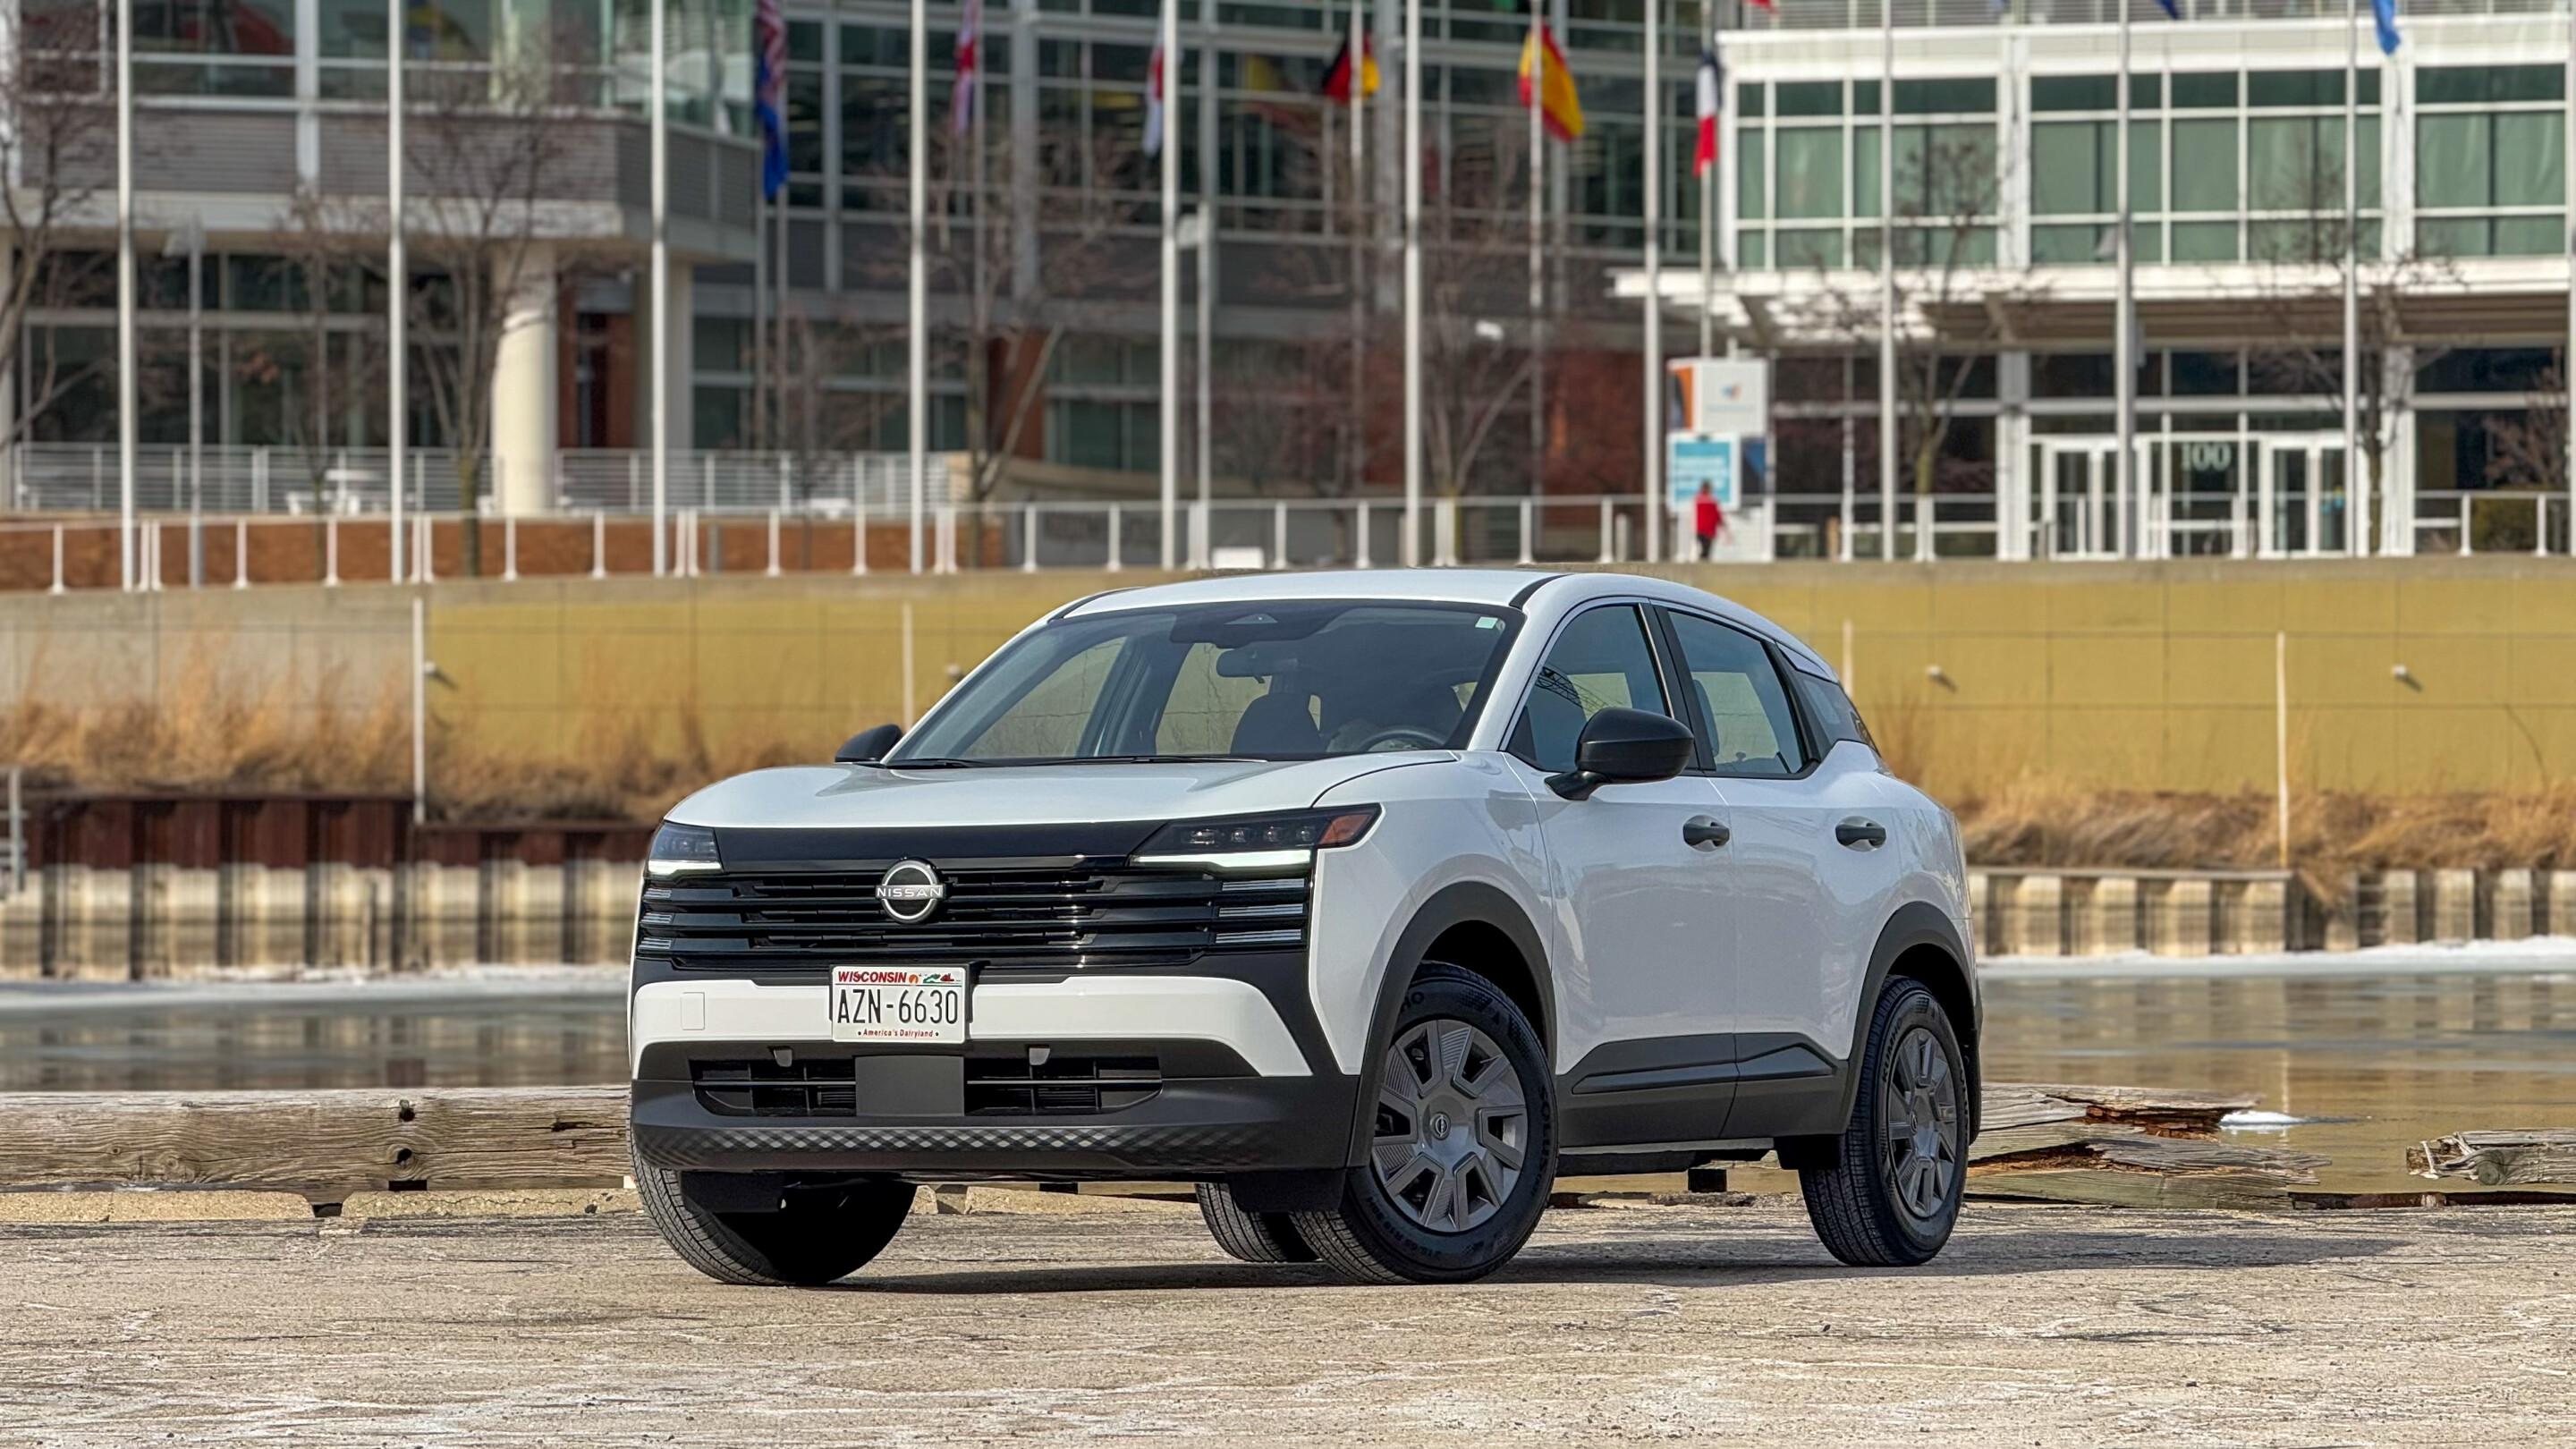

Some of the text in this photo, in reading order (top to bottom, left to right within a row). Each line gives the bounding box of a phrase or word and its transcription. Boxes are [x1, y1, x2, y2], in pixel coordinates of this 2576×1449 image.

[2182, 443, 2233, 471] 100
[877, 887, 941, 897] NISSAN
[838, 970, 907, 983] WISCONSIN
[837, 988, 958, 1024] AZN-6630
[863, 1029, 933, 1038] America's Dairyland
